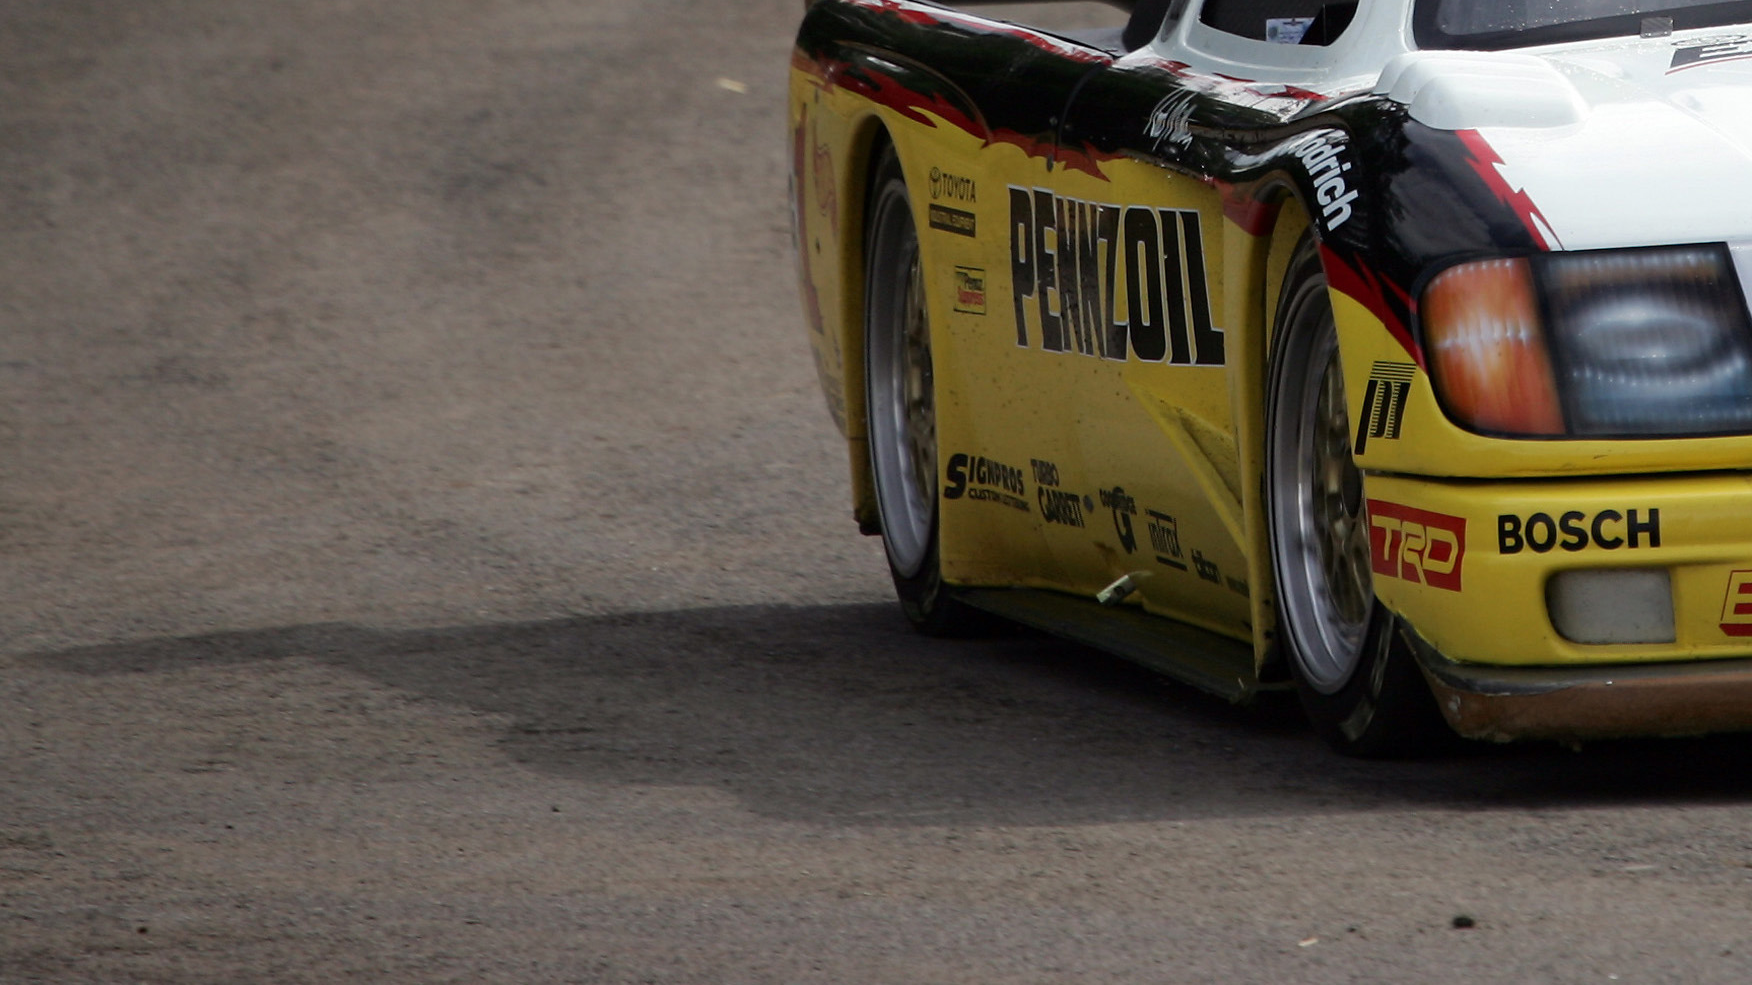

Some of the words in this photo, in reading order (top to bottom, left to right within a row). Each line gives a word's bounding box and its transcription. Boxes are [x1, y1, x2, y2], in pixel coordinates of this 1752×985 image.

[942, 172, 977, 204] TOYOTA
[1006, 183, 1226, 368] PENNZOIL
[1370, 514, 1462, 585] TRD
[1497, 507, 1662, 555] BOSCH
